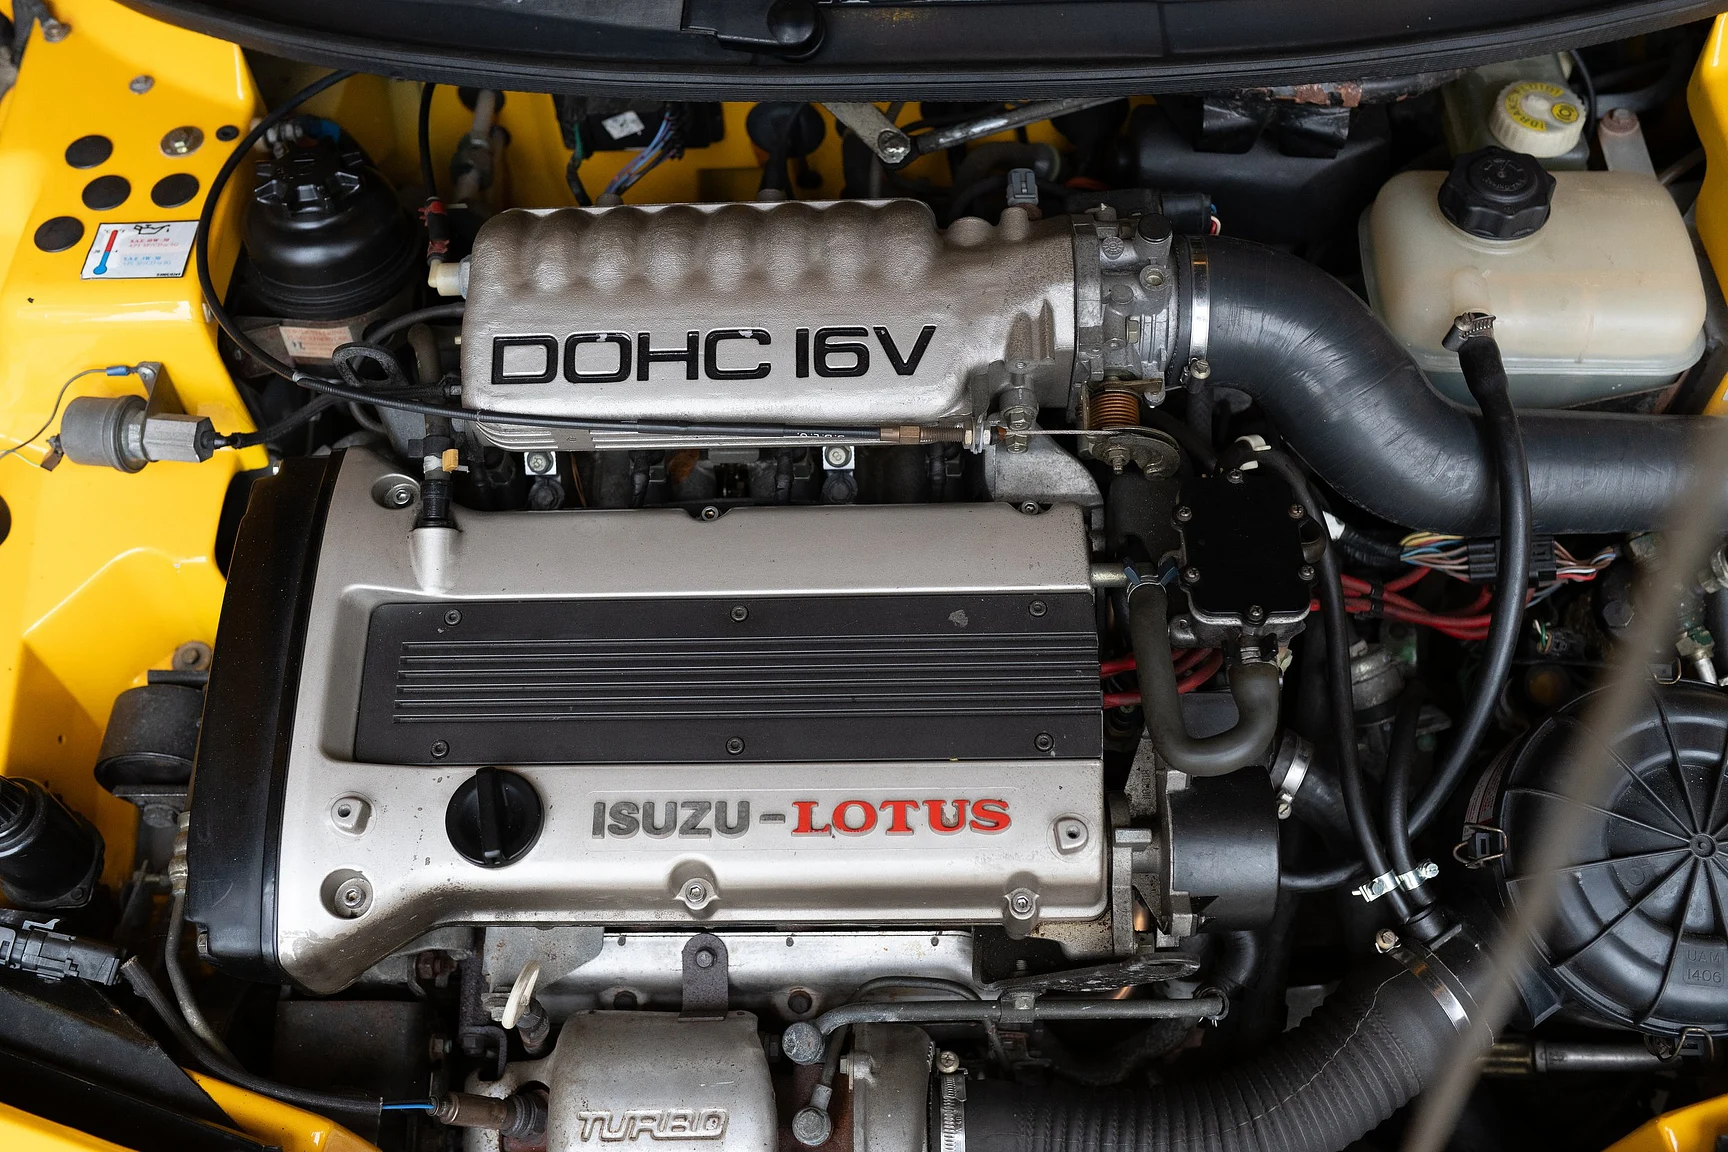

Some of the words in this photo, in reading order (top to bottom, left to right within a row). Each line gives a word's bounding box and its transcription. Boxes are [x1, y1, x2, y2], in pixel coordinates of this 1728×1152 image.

[491, 328, 772, 384] DOHC
[796, 325, 937, 378] 16V
[1687, 950, 1720, 964] UAM
[1687, 969, 1722, 983] 1406
[577, 1107, 729, 1142] TURBO
